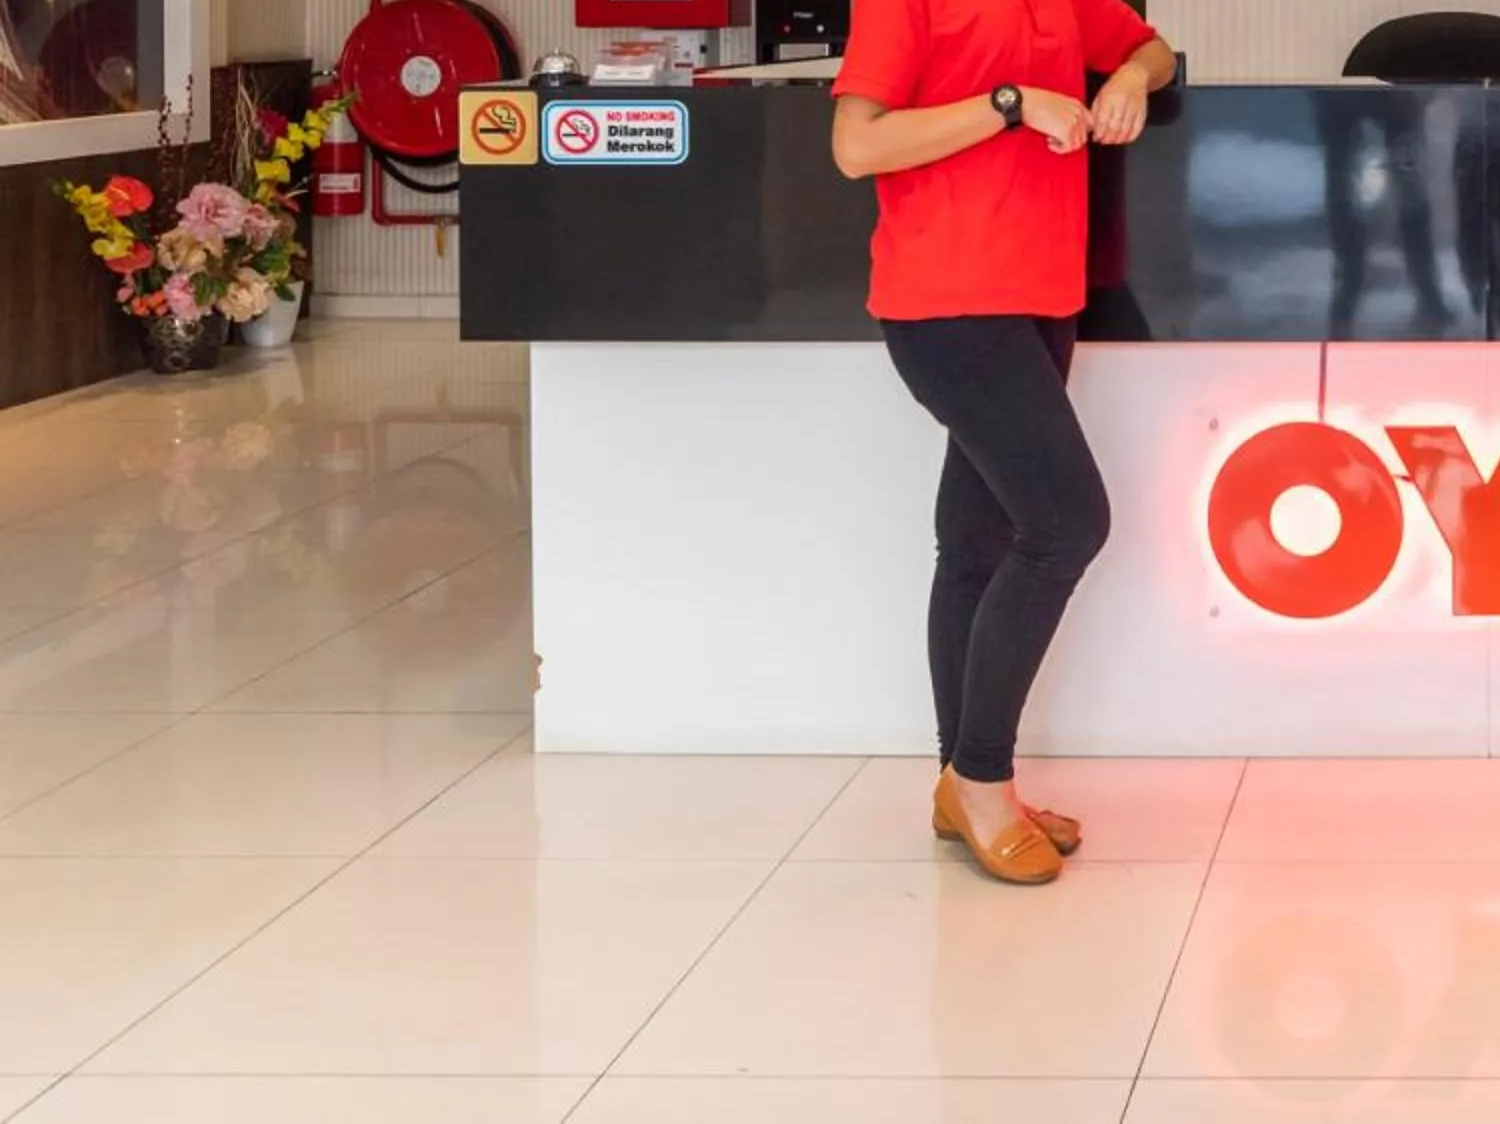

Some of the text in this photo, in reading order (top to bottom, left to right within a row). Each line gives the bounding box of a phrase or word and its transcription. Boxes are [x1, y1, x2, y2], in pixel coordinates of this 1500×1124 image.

[607, 110, 675, 121] NO SMOKING
[607, 124, 674, 139] Dilarang
[607, 140, 674, 153] Merokok
